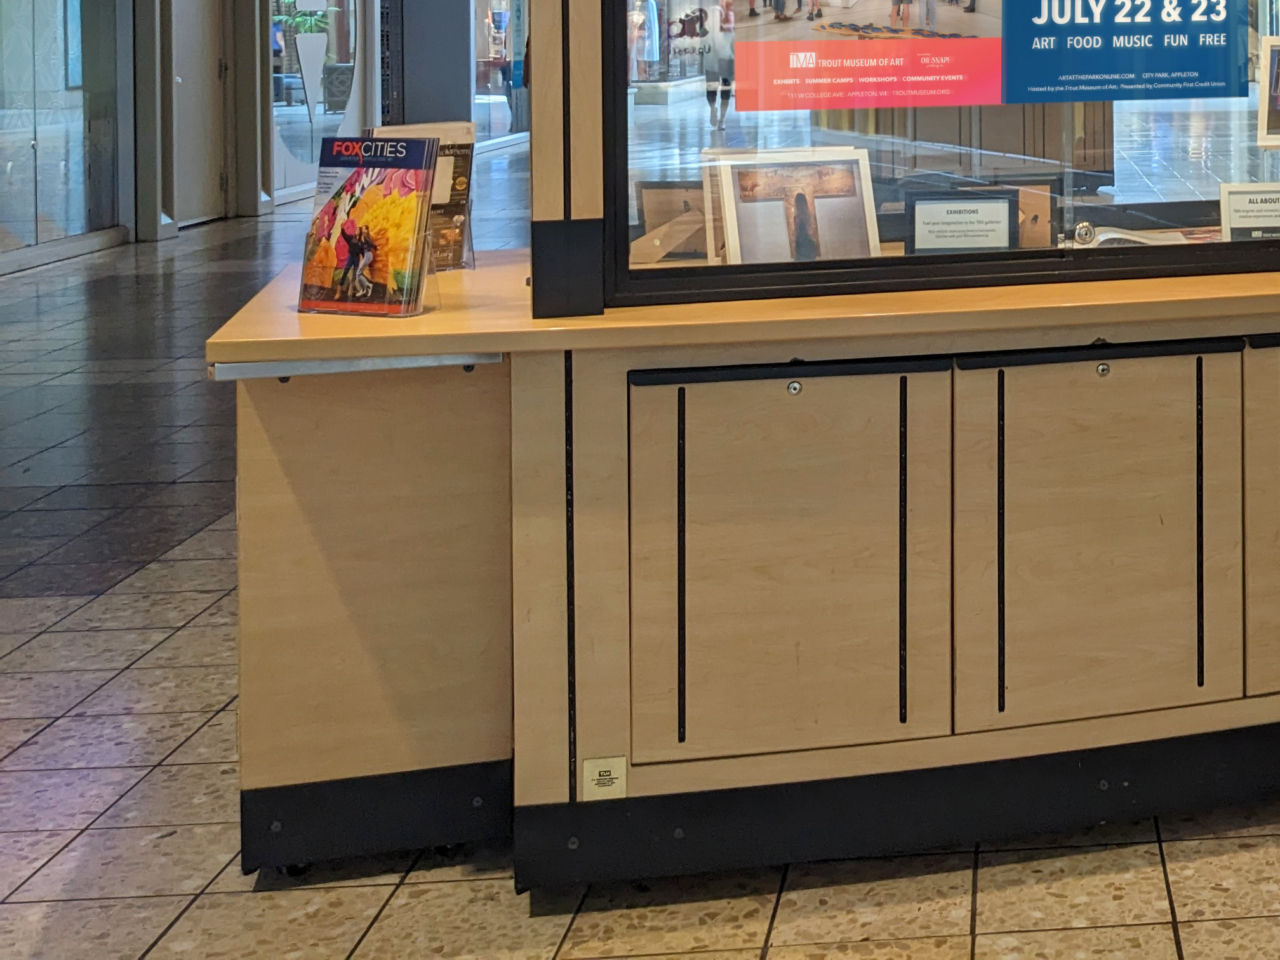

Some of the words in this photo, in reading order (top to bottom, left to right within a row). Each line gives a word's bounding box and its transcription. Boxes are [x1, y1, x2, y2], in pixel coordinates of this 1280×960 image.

[1032, 37, 1056, 49] ART
[1067, 36, 1102, 49] FOOD
[1112, 35, 1153, 48] MUSIC
[1164, 34, 1188, 46] FUN
[1199, 33, 1227, 46] FREE
[790, 52, 815, 68] TMA
[817, 59, 842, 68] TROUT
[843, 58, 877, 68] MUSEUM
[878, 57, 889, 67] OF
[890, 57, 904, 67] ART
[1171, 71, 1198, 79] APPLETON
[1153, 81, 1182, 89] Community
[1248, 197, 1259, 205] ALL
